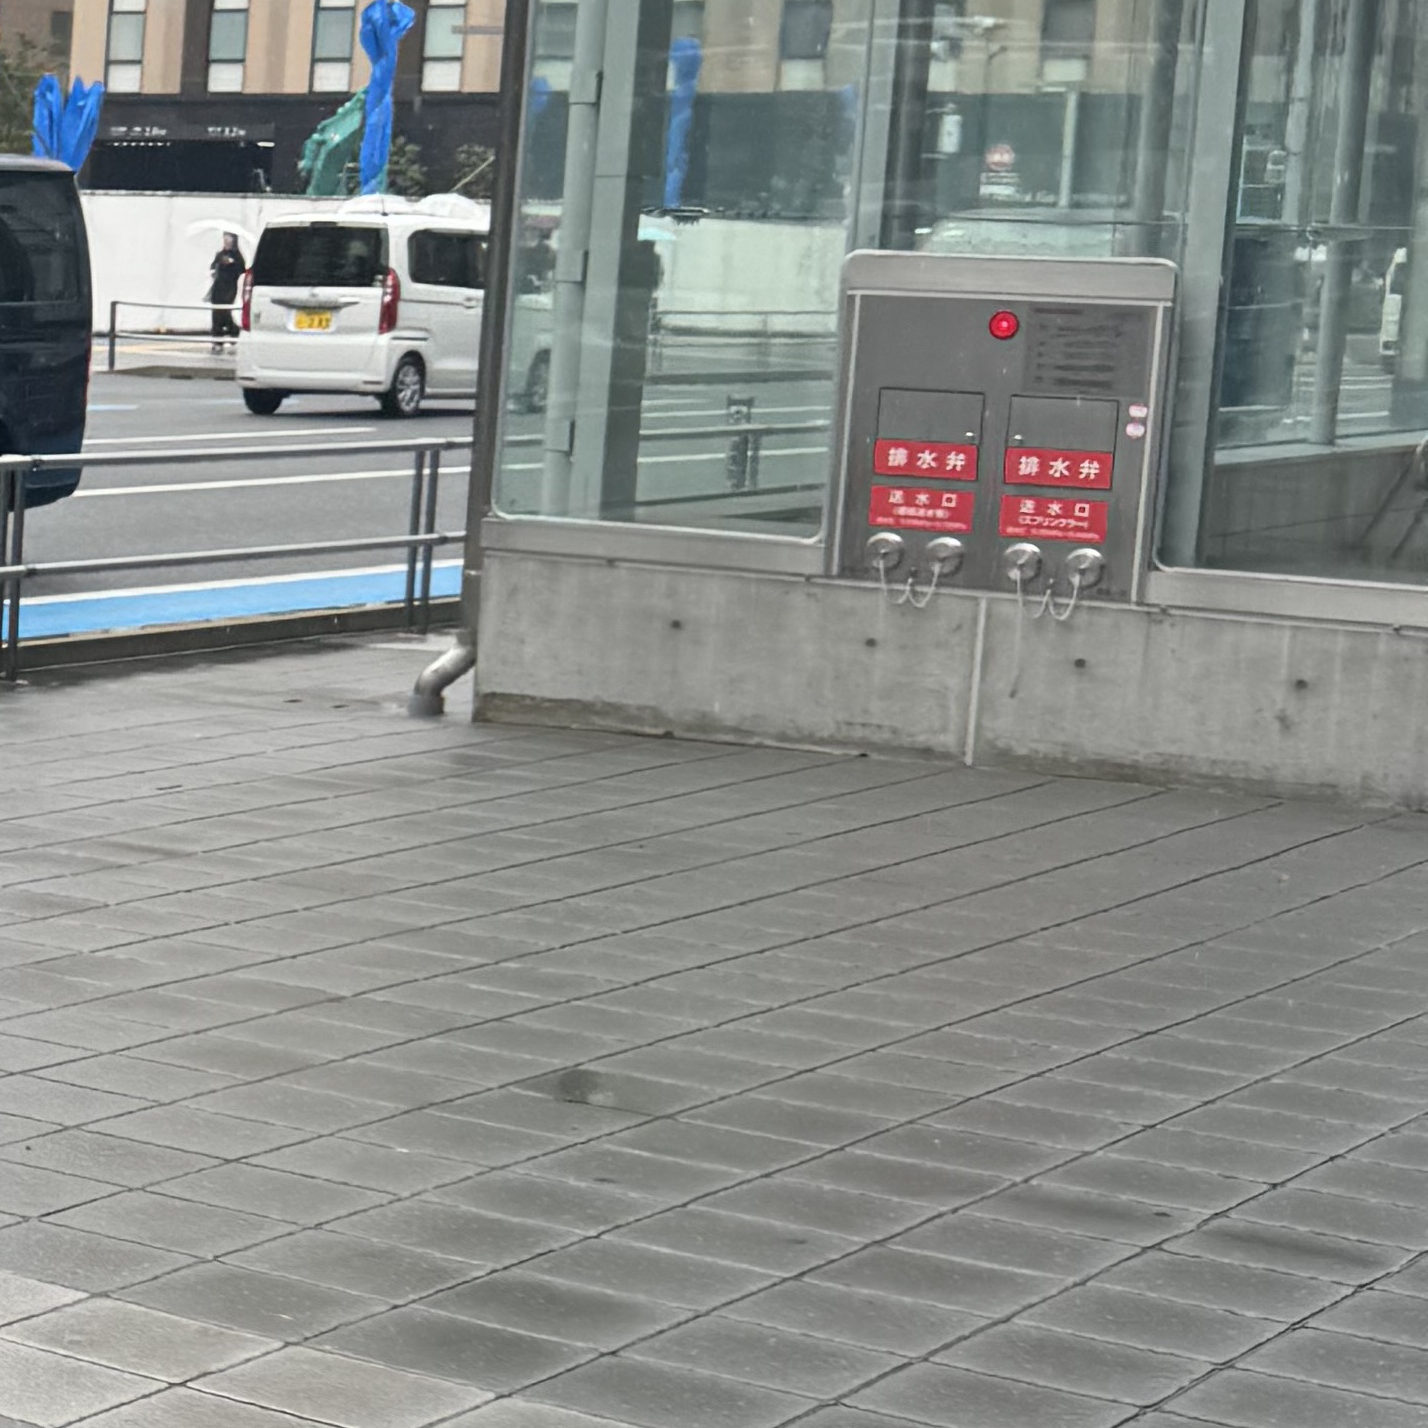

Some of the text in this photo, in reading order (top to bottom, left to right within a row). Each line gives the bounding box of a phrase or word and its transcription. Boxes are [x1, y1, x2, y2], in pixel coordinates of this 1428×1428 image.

[887, 447, 966, 471] 排水弁
[1018, 455, 1101, 480] 排水弁
